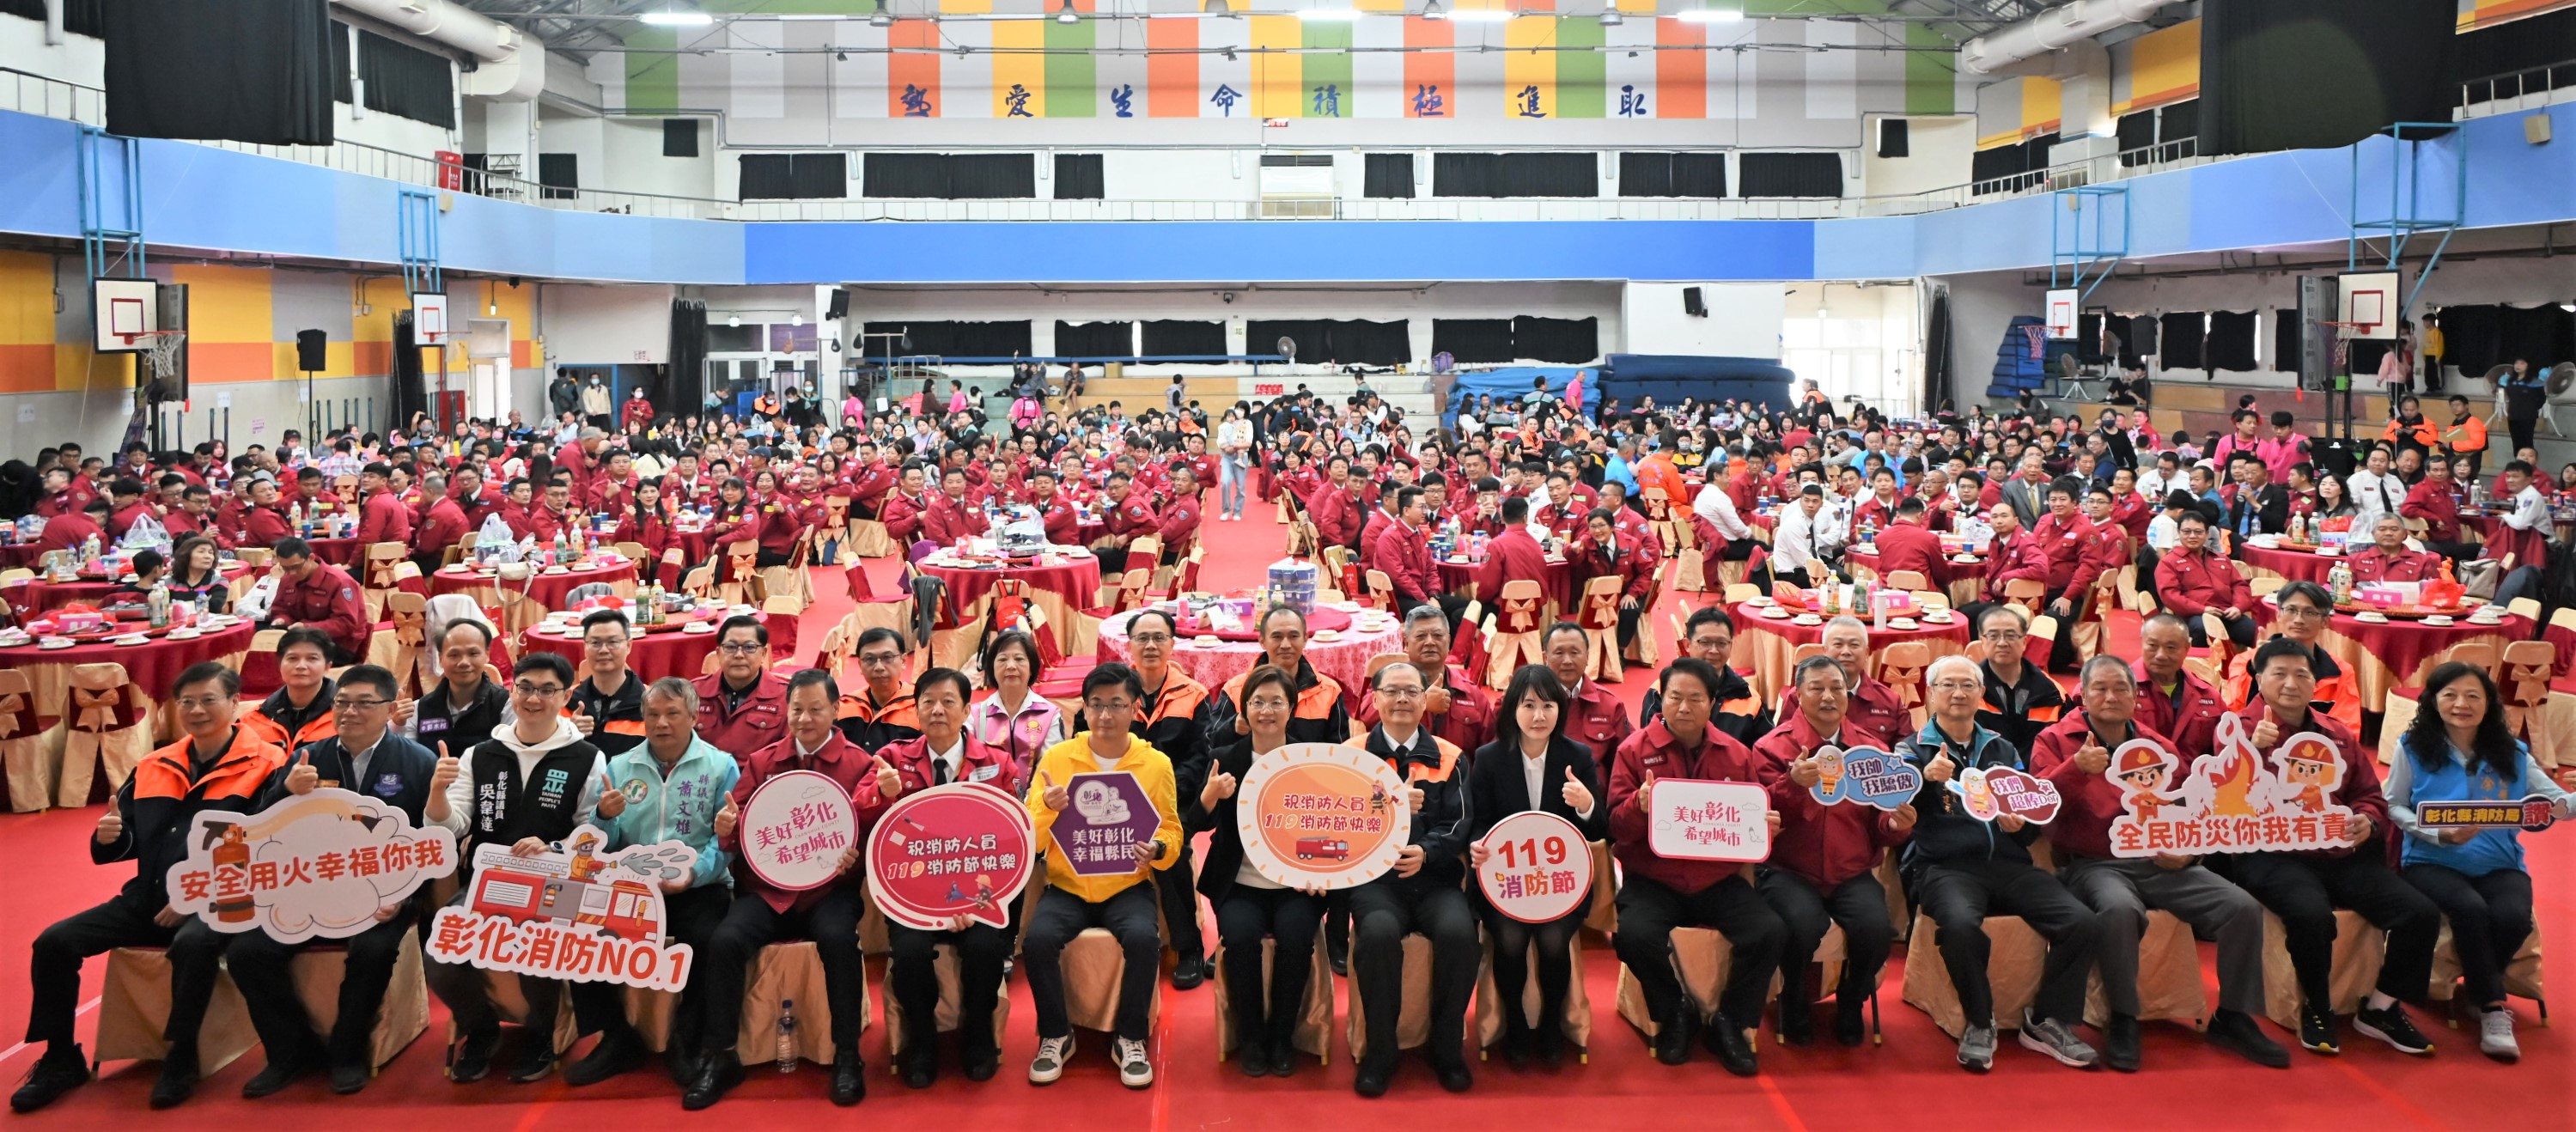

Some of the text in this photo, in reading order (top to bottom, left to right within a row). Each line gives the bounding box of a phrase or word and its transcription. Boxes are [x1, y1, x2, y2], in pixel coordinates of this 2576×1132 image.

[1848, 758, 1884, 780] 我帥
[494, 770, 509, 820] 彰化縣議員
[696, 774, 709, 812] 縣議員
[1862, 772, 1915, 796] 我驕傲
[1991, 776, 2025, 795] 我們
[479, 783, 496, 832] 吳韋達
[539, 796, 561, 805] PEOPLE'S
[675, 780, 693, 836] 蕭文雄
[1284, 794, 1365, 812] 祝消防人員
[1673, 801, 1741, 824] 美好彰化
[755, 801, 837, 850] 美好彰化
[2425, 808, 2521, 824] 彰化縣消防局
[1072, 826, 1136, 846] 美好彰化
[1684, 826, 1741, 847] 希望城市
[2116, 812, 2348, 850] 全民防災你我有責
[775, 831, 846, 865] 希望城市
[907, 834, 997, 856] 祝消防人員
[1073, 843, 1136, 863] 幸福縣民
[1498, 836, 1567, 868] 119
[180, 838, 445, 902] 安全用火幸福你我
[1496, 869, 1576, 899] 消防節
